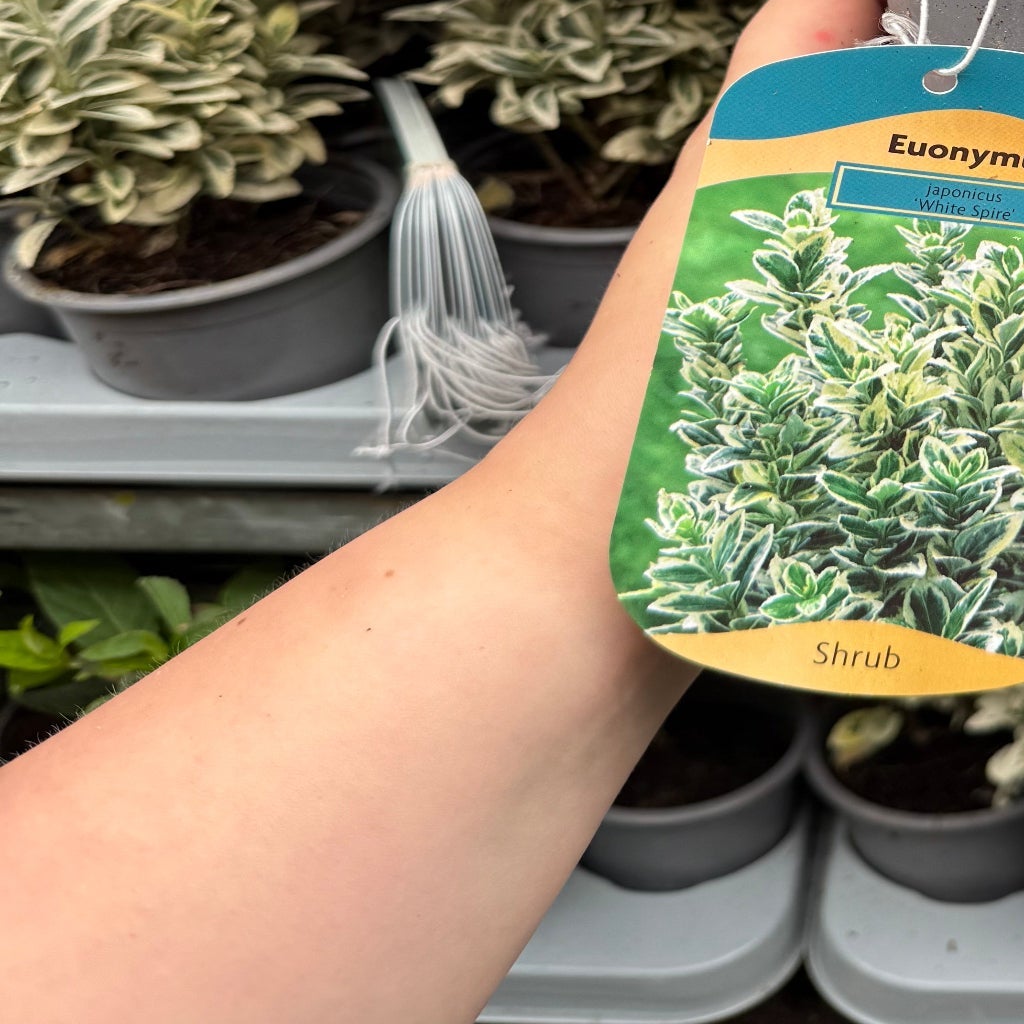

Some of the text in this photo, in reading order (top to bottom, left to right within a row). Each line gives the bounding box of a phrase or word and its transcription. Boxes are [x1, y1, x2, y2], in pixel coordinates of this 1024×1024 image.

[925, 183, 1003, 203] japonicus
[914, 197, 1015, 221] 'White Spire'
[813, 641, 901, 669] Shrub
